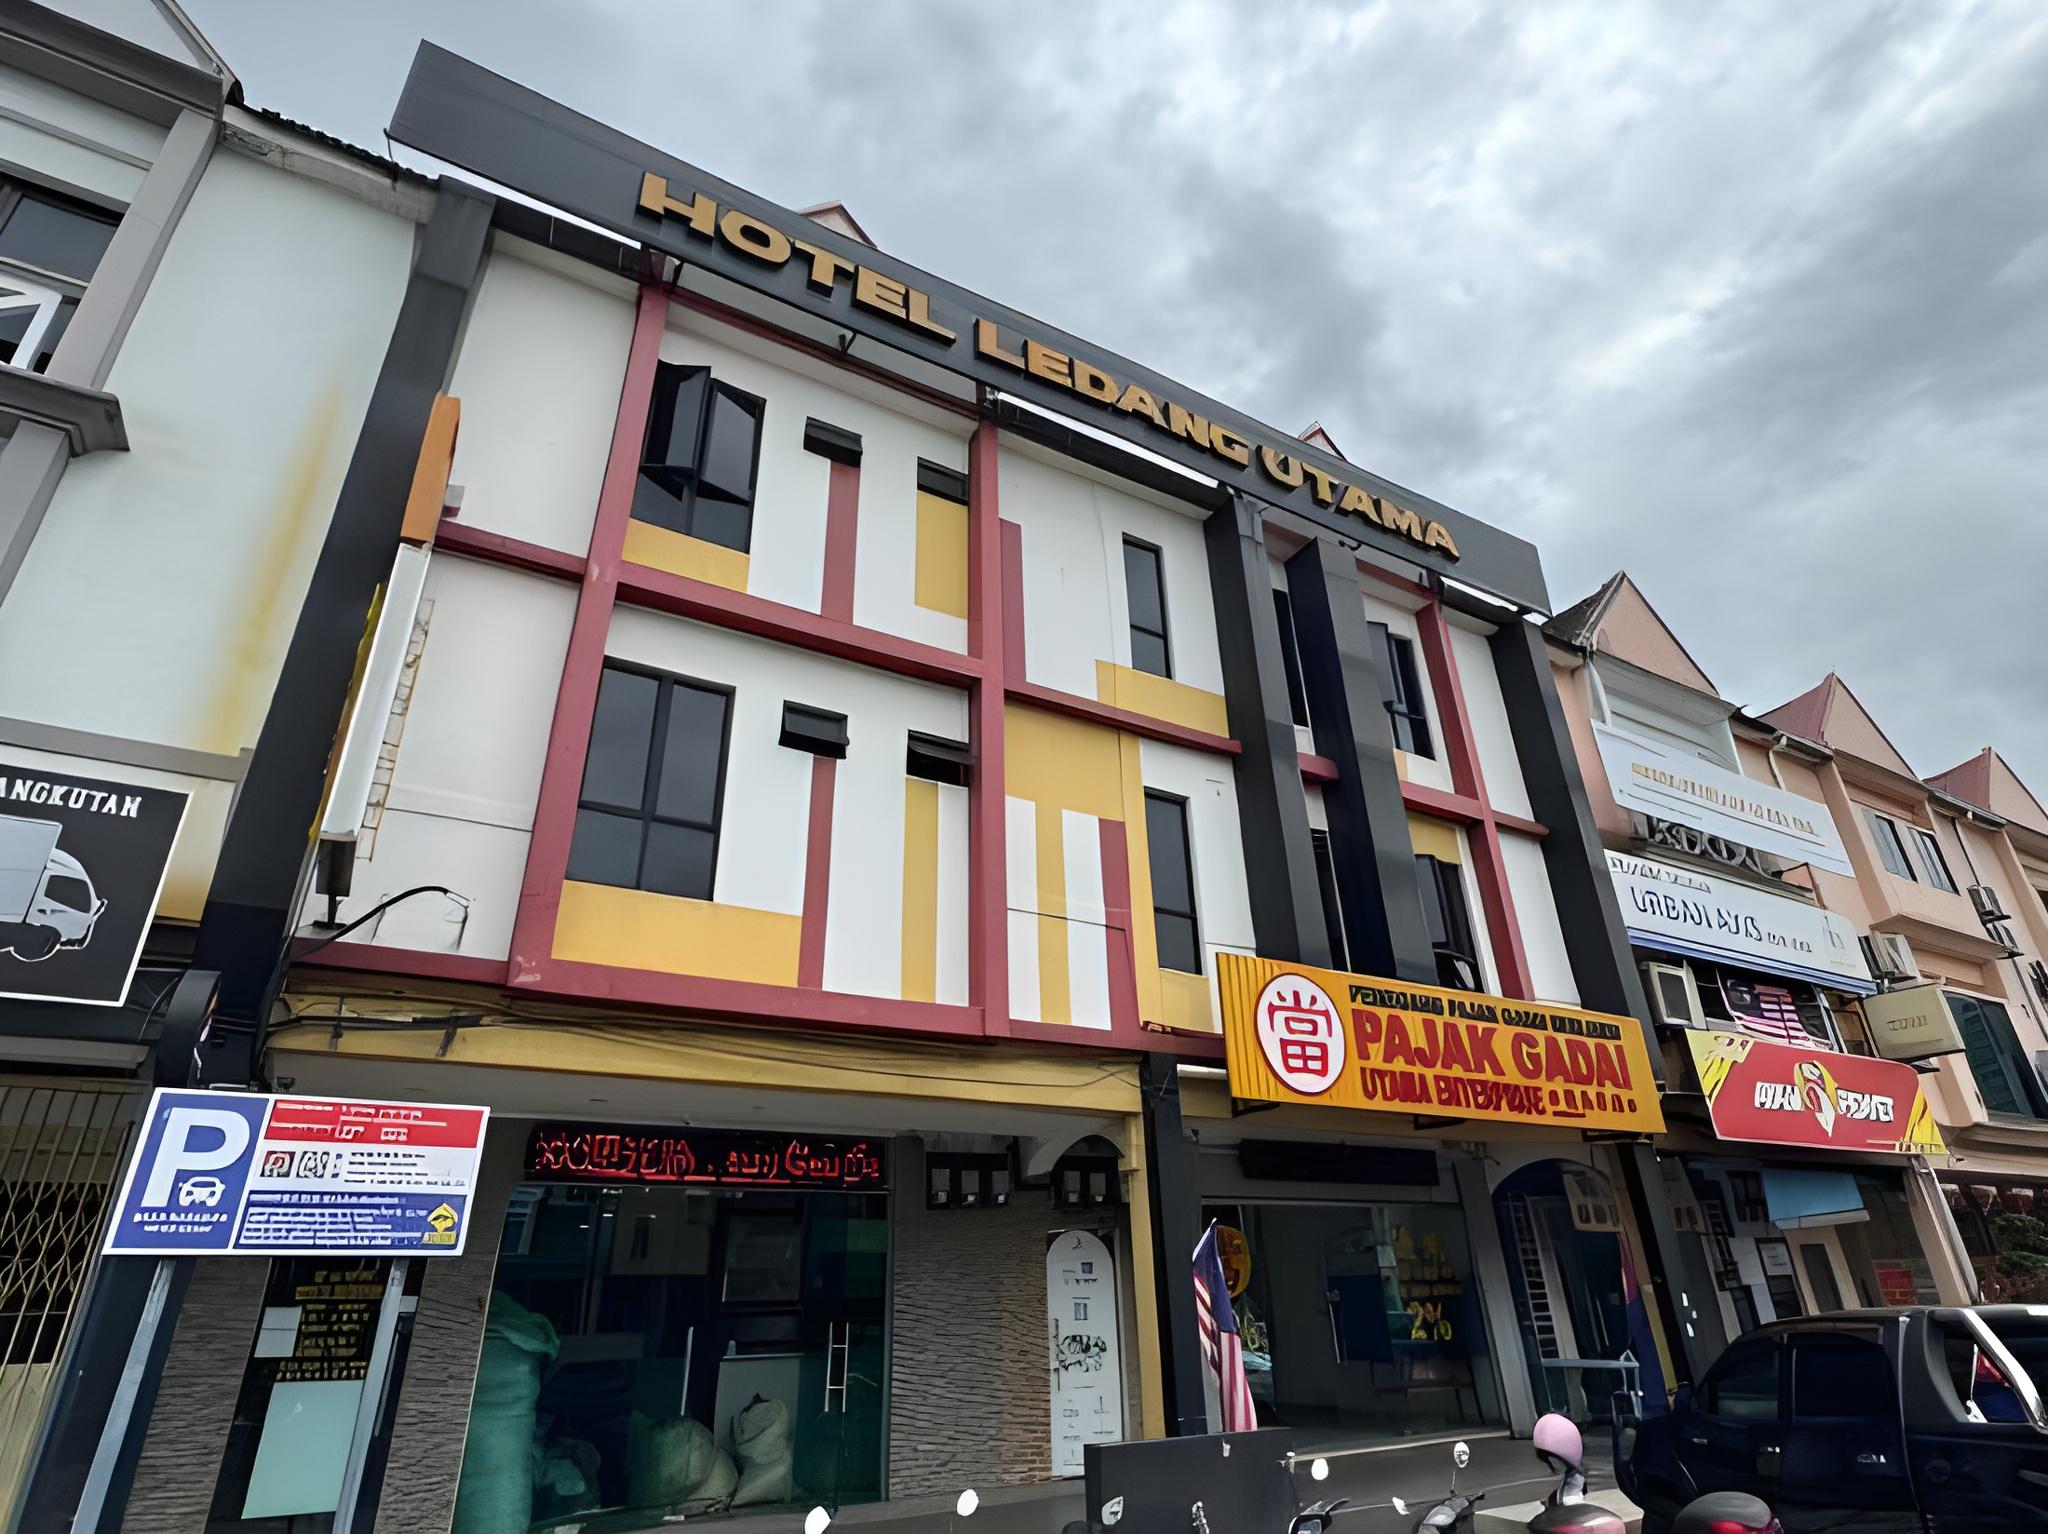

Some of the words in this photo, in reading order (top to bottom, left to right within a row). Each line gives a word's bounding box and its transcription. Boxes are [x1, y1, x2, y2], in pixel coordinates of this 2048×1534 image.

[637, 172, 957, 345] HOTEL
[975, 317, 1252, 468] LEDANG
[1258, 445, 1462, 561] UTAMA
[1268, 989, 1333, 1078] 當
[1351, 1008, 1506, 1077] PAJAK
[1511, 1032, 1632, 1090] GADAI
[140, 1107, 251, 1208] P
